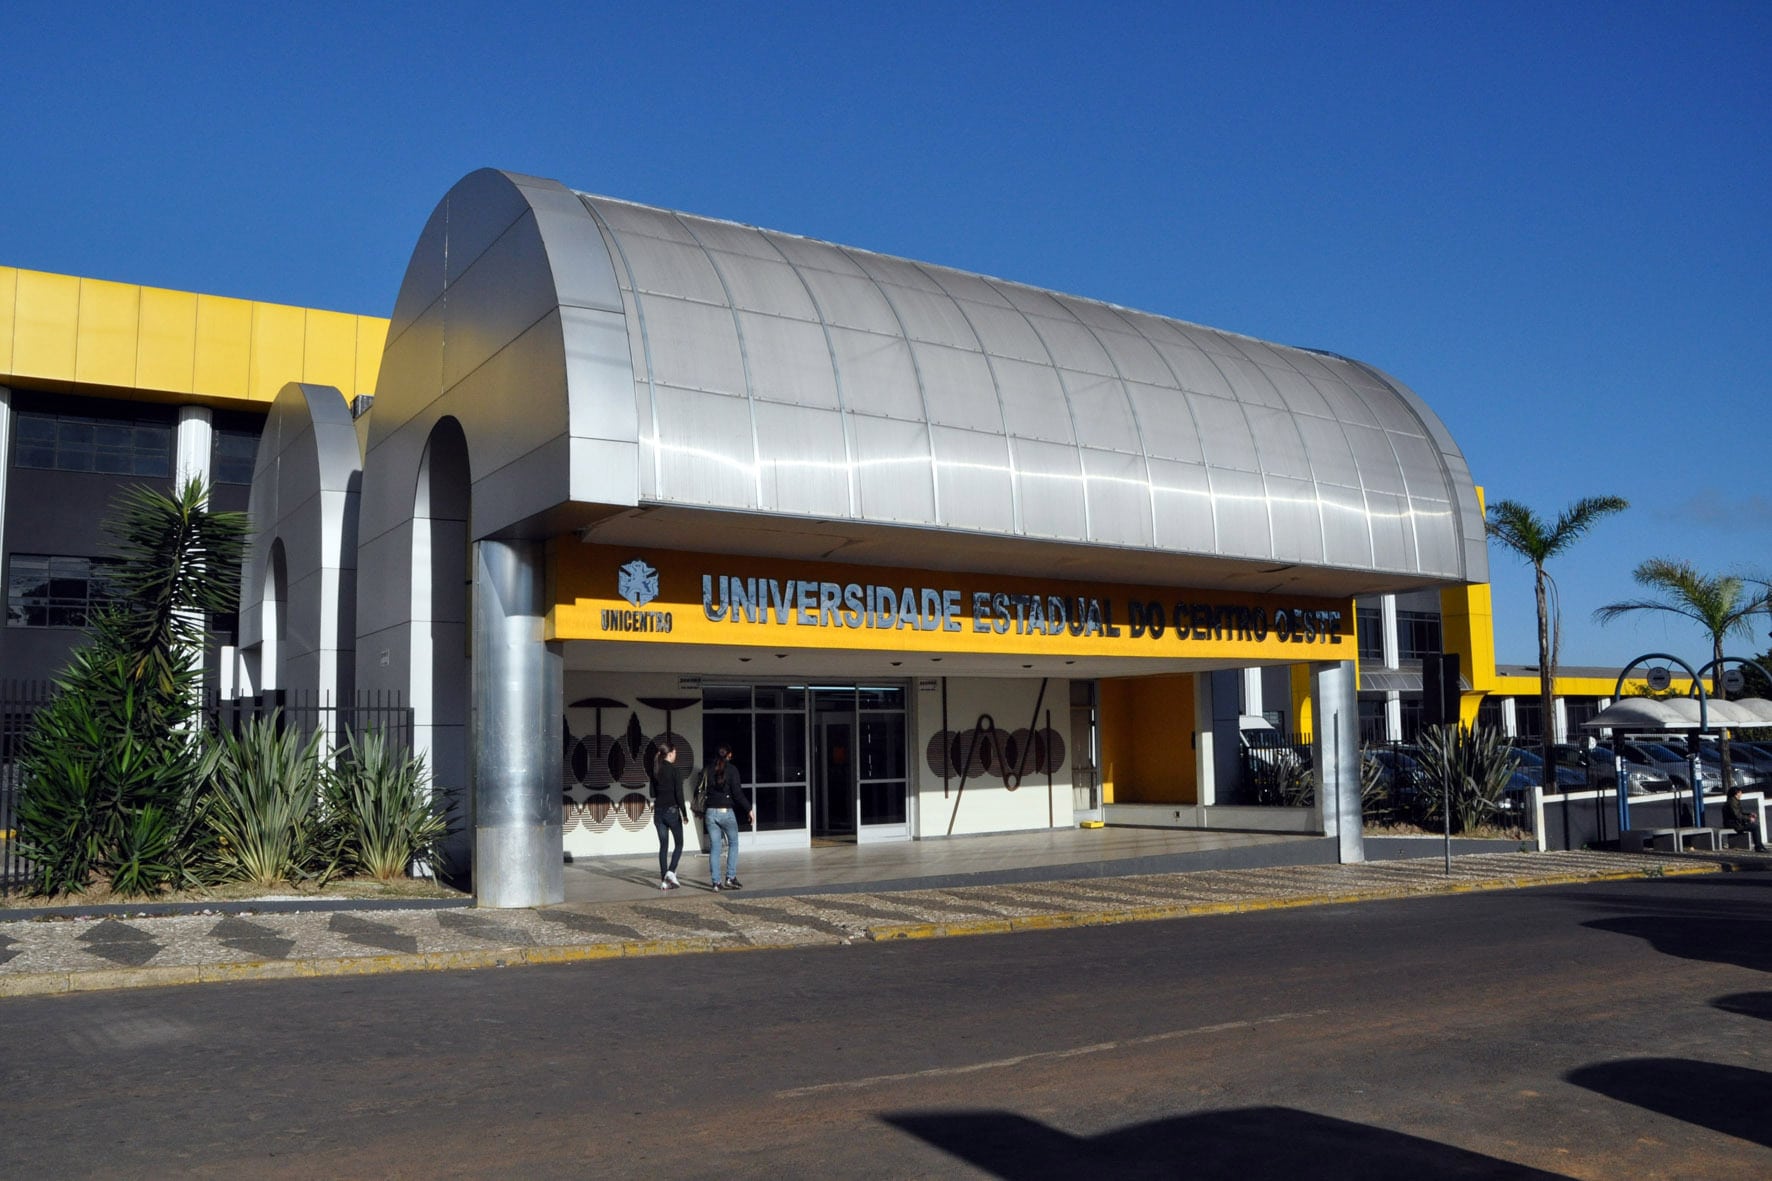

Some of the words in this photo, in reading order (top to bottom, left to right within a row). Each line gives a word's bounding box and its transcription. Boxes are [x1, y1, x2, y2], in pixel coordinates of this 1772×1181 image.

[601, 609, 673, 633] UNICENTRO
[702, 574, 962, 632] UNIVERSIDADE
[972, 591, 1121, 637] ESTADUAL
[1128, 602, 1166, 640] DO
